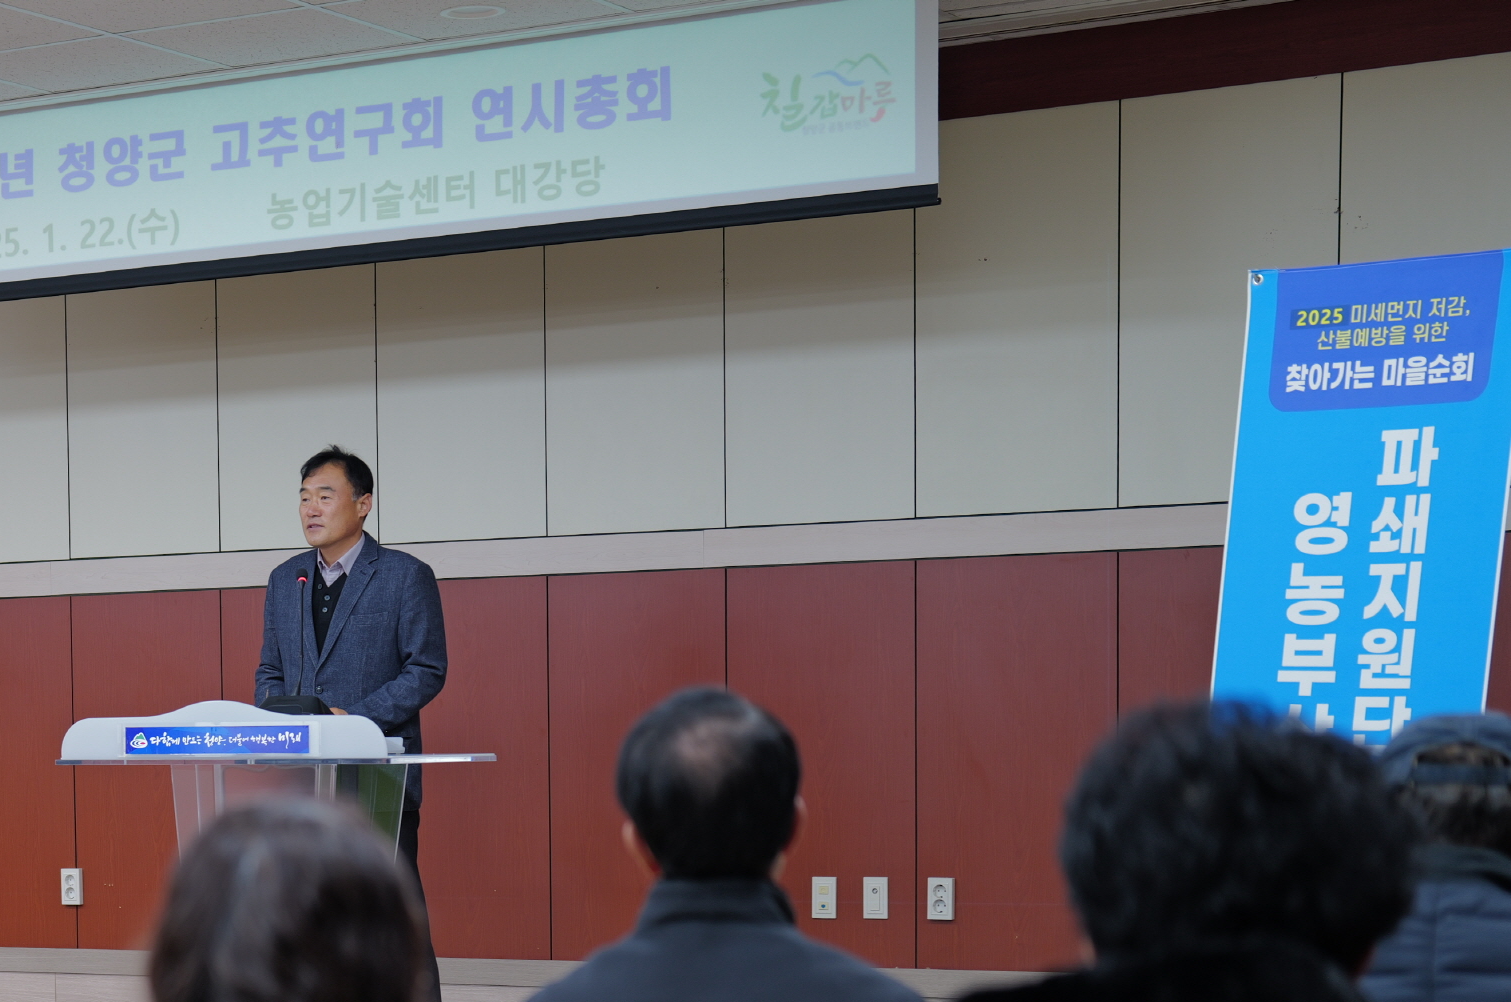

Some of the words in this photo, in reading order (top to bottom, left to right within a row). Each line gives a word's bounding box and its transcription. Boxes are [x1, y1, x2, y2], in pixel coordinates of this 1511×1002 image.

[56, 128, 187, 194] 청양군
[209, 95, 444, 172] 고추연구회
[471, 65, 673, 143] 연시총회
[42, 222, 67, 254] 1.
[79, 207, 181, 252] 22.(수)
[265, 170, 477, 231] 농업기술센터
[494, 155, 606, 205] 대강당
[1295, 307, 1344, 327] 2025
[1350, 299, 1423, 324] 미세먼지
[1427, 295, 1471, 319] 저감,
[1316, 324, 1407, 351] 산불예방을
[1412, 321, 1450, 344] 위한
[1284, 359, 1375, 393] 찾아가는
[1381, 352, 1476, 387] 마을순회
[182, 735, 202, 746] 만드는
[278, 730, 302, 749] 미래
